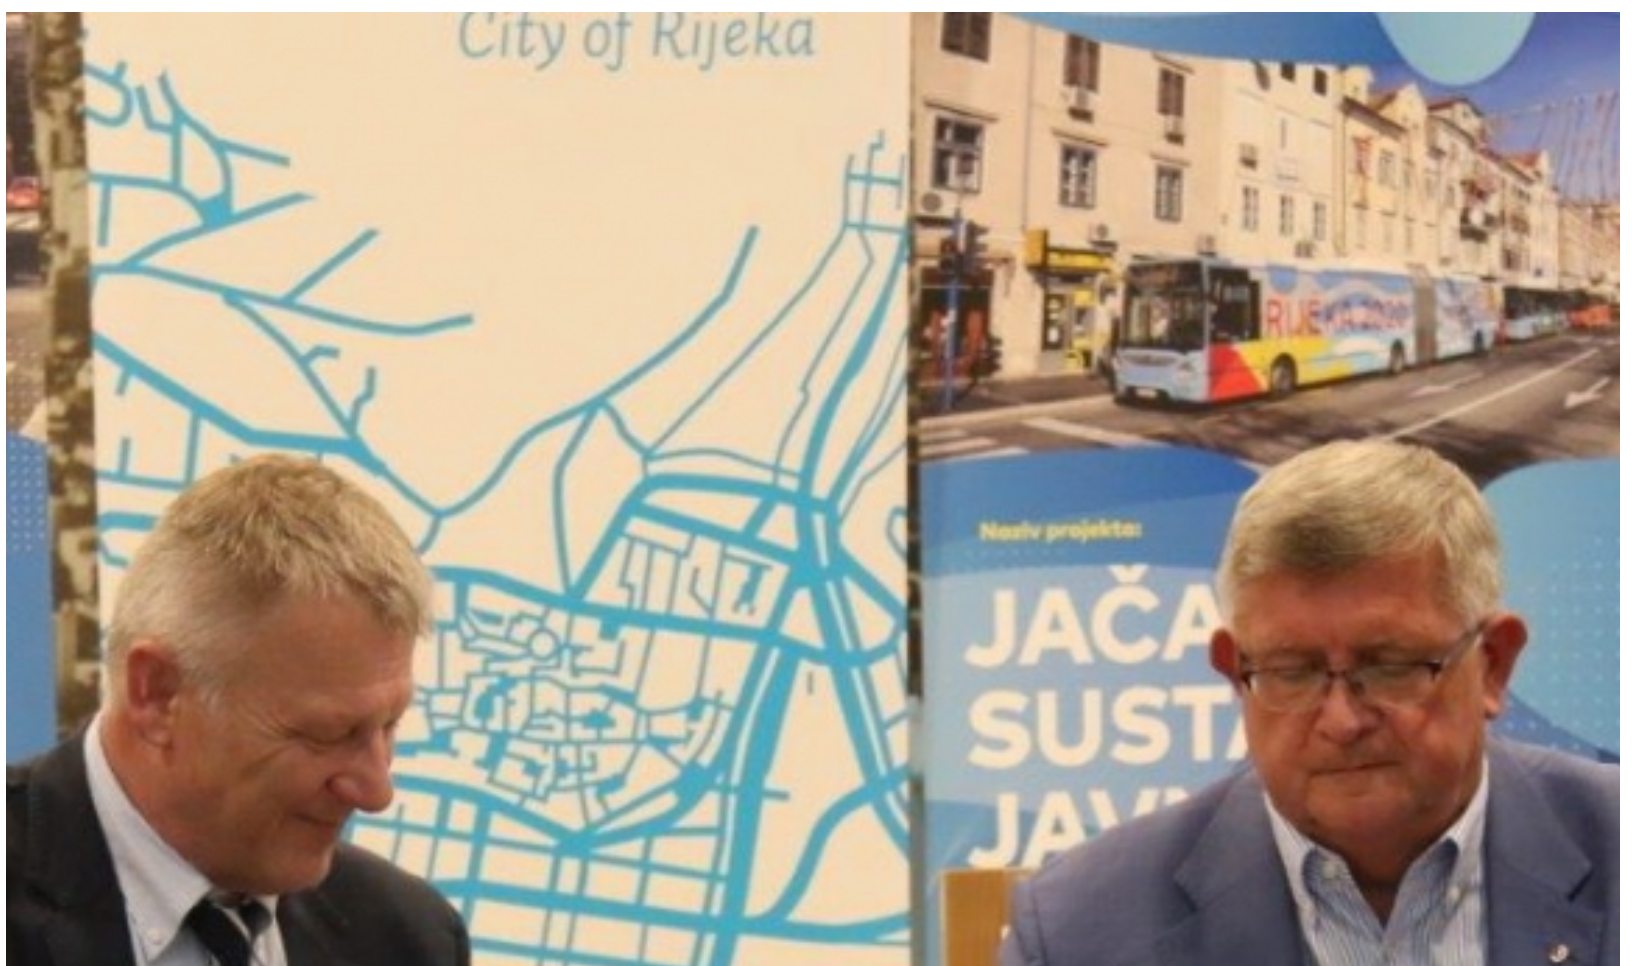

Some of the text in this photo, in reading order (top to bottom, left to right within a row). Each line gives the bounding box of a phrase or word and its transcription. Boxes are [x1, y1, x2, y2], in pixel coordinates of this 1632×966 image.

[458, 12, 815, 71] City of Rijeka
[979, 519, 1042, 542] Naziv
[964, 563, 1222, 669] JAČA
